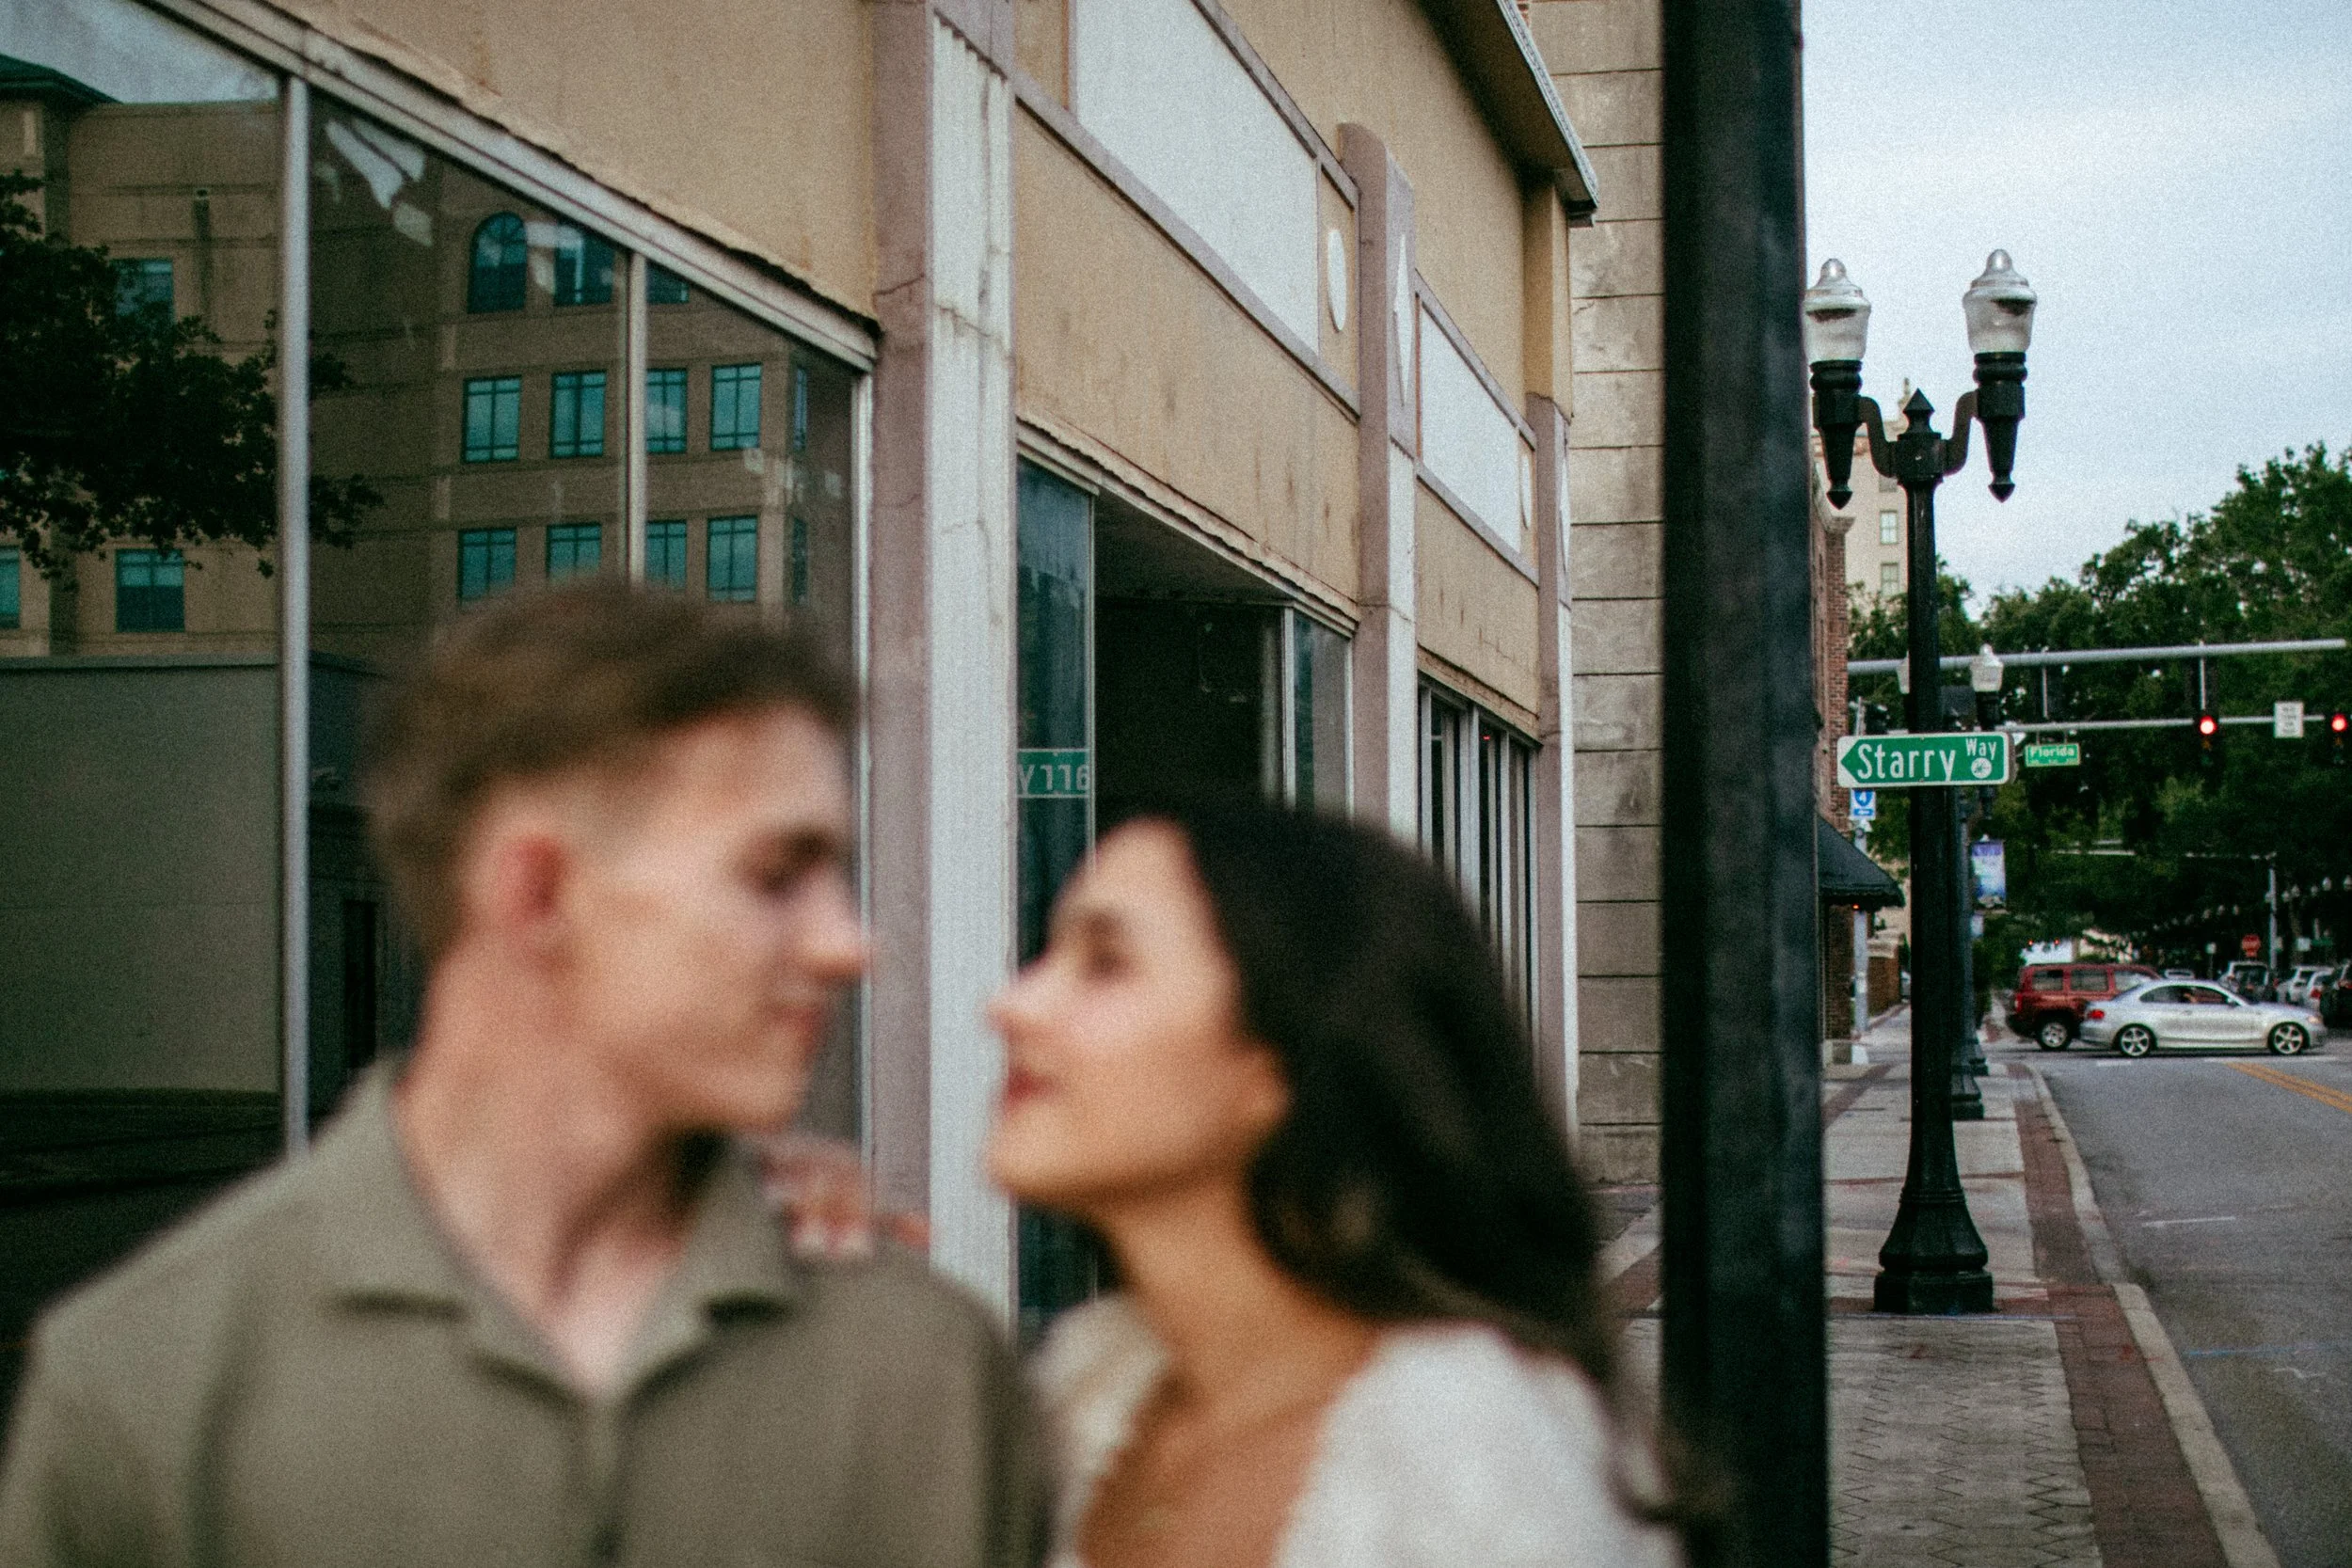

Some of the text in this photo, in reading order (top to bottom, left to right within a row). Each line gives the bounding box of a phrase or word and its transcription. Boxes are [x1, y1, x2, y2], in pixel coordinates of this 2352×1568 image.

[2030, 746, 2074, 757] Florida
[1857, 737, 1997, 782] Starry Way
[1859, 791, 1867, 803] 4
